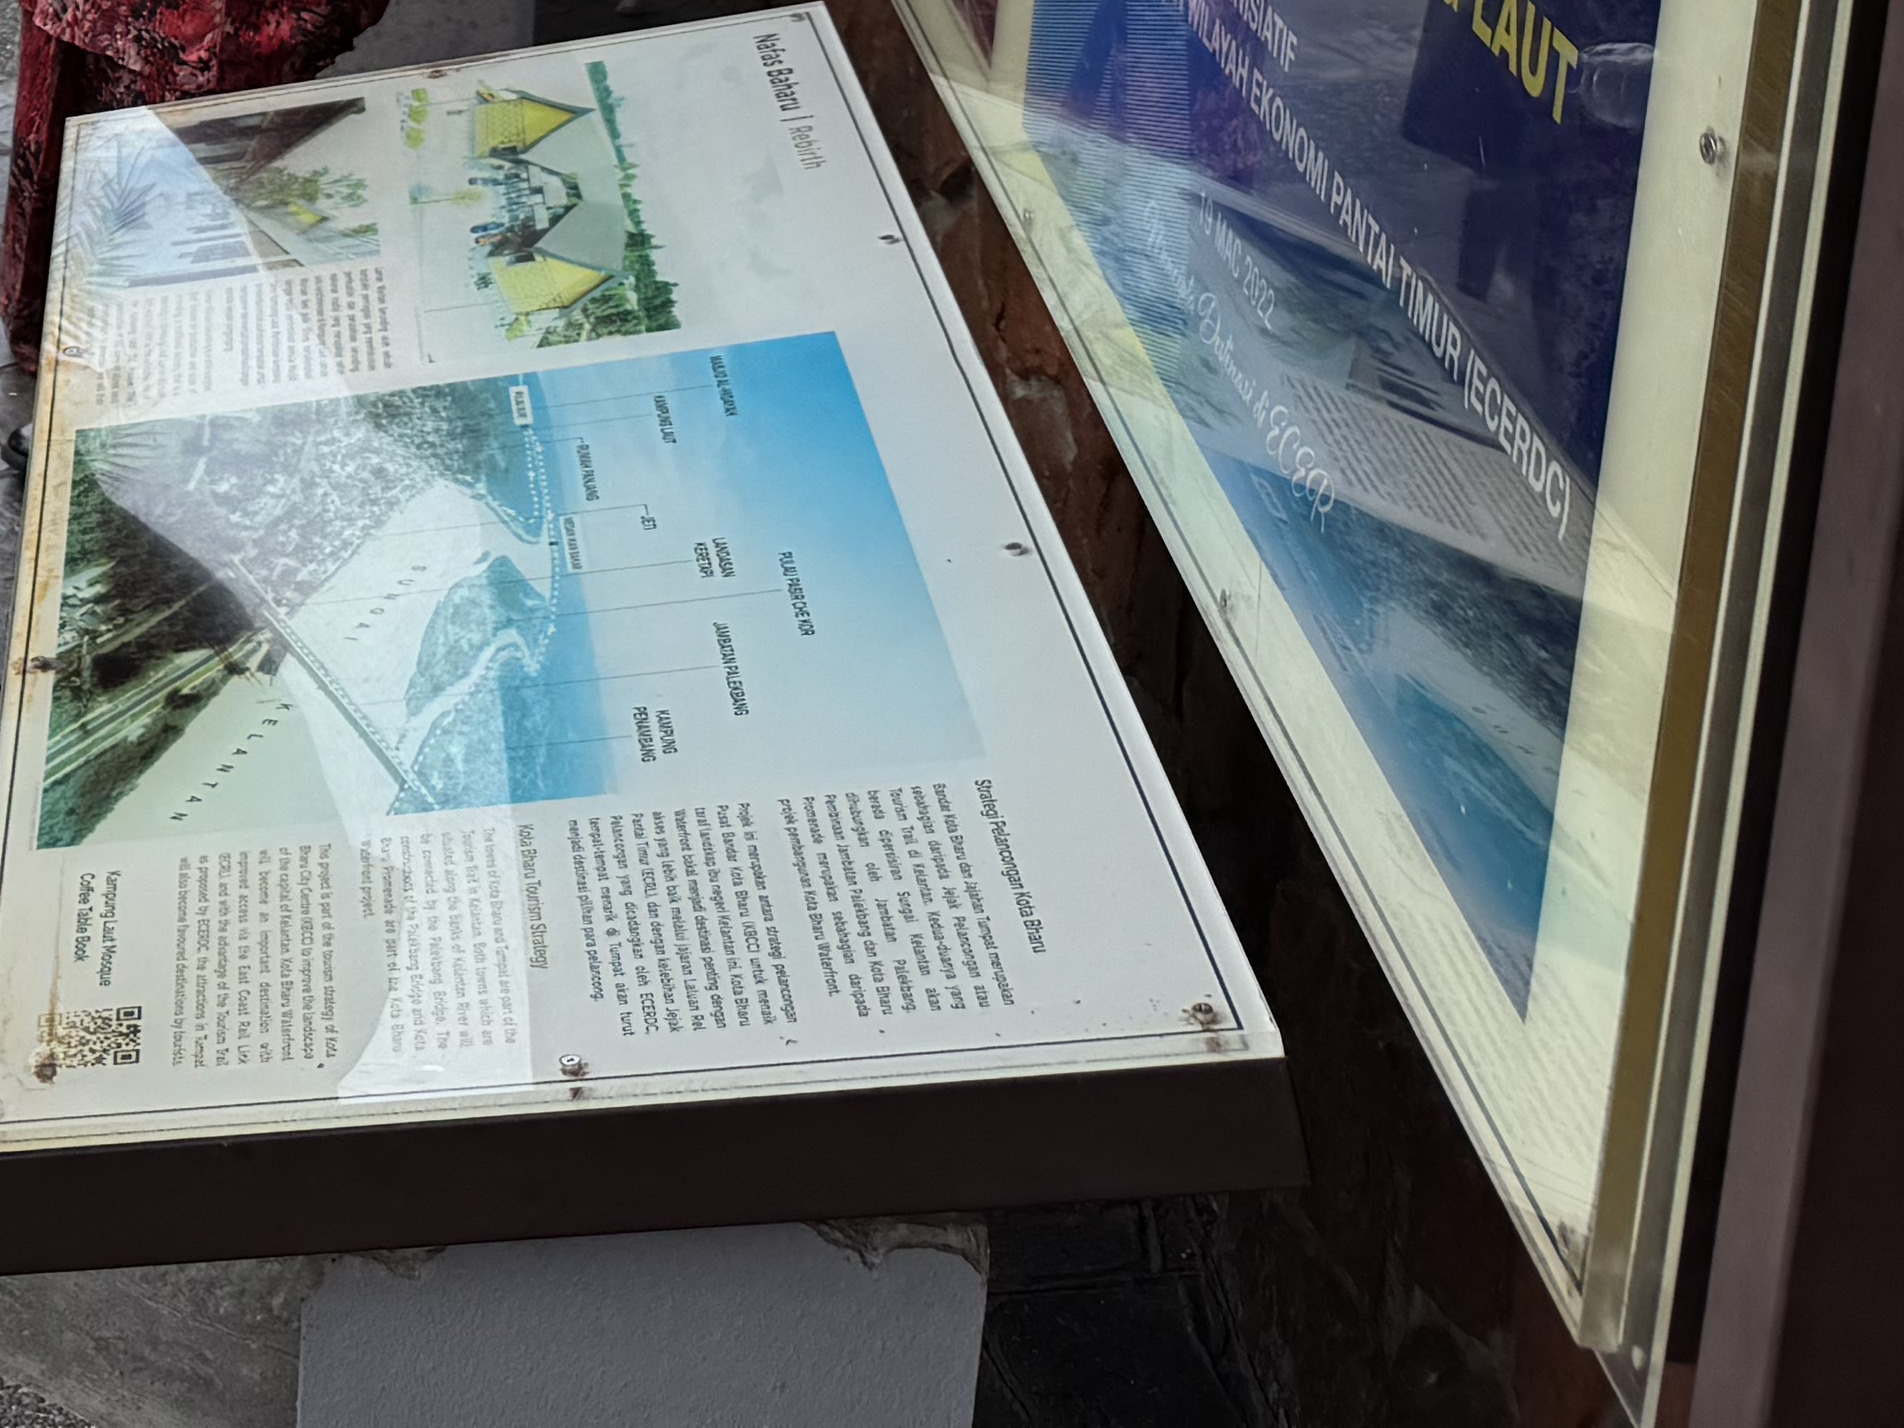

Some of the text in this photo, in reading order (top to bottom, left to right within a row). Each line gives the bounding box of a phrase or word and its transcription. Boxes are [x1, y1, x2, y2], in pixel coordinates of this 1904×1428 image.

[753, 32, 826, 170] Nafas Baharu Rebirth
[1199, 190, 1276, 331] 19 MAC 2022
[1250, 68, 1329, 204] EKONOMI
[1330, 169, 1393, 291] PANTAI
[1398, 255, 1462, 382] TIMUR
[1463, 346, 1571, 541] (ECERDC)
[653, 394, 677, 444] KAMPUNG LAUT
[581, 469, 600, 501] PANJANG
[693, 541, 714, 578] KERETAPI
[711, 537, 735, 577] LANDASAN
[778, 551, 798, 576] PULAU
[790, 600, 811, 618] CHE
[712, 621, 749, 715] JAMBATAN PALEKBANG
[169, 702, 293, 822] KELANTAN
[632, 706, 656, 762] PENAMBANG
[654, 709, 678, 754] KAMPUNG
[517, 823, 548, 969] Kota Bharu Tourism Strategy
[973, 778, 1046, 953] Strategi Pelancongan Kota Bharu
[76, 872, 95, 961] Coffee Table Book
[95, 870, 121, 987] Kampung Laut Mosque
